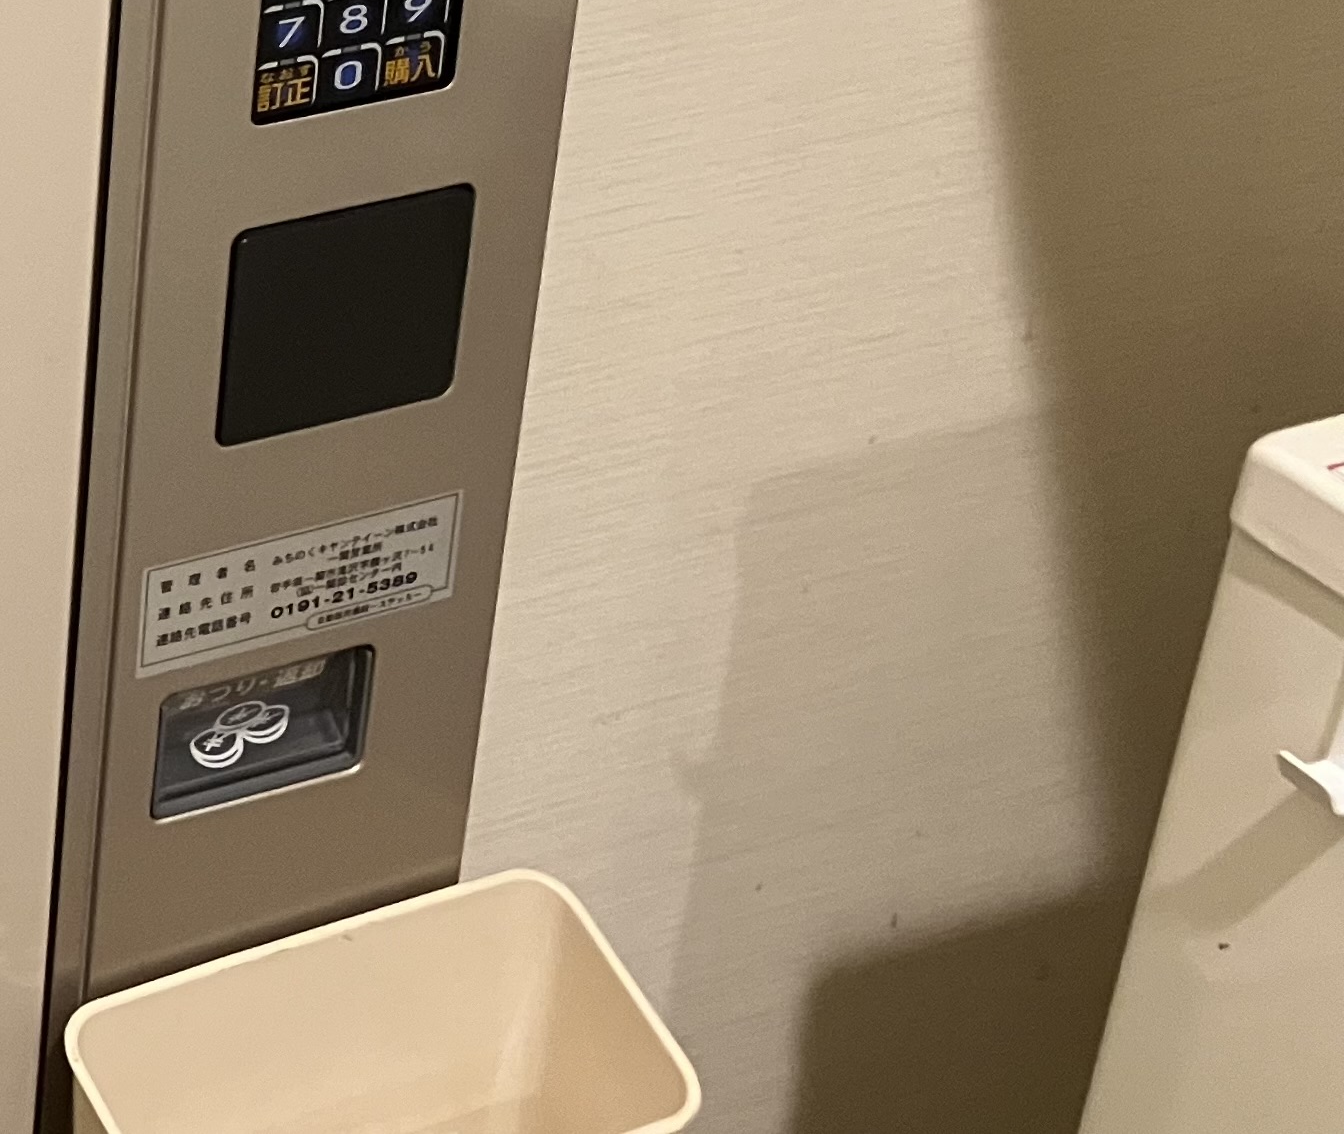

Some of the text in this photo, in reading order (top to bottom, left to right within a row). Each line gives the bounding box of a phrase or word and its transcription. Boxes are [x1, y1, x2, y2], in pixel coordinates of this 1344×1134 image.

[278, 16, 305, 48] 7
[339, 4, 368, 34] 8
[333, 60, 362, 90] 0
[384, 55, 436, 87] 購入
[257, 76, 312, 112] 訂正
[270, 571, 418, 619] 0191-21-5389
